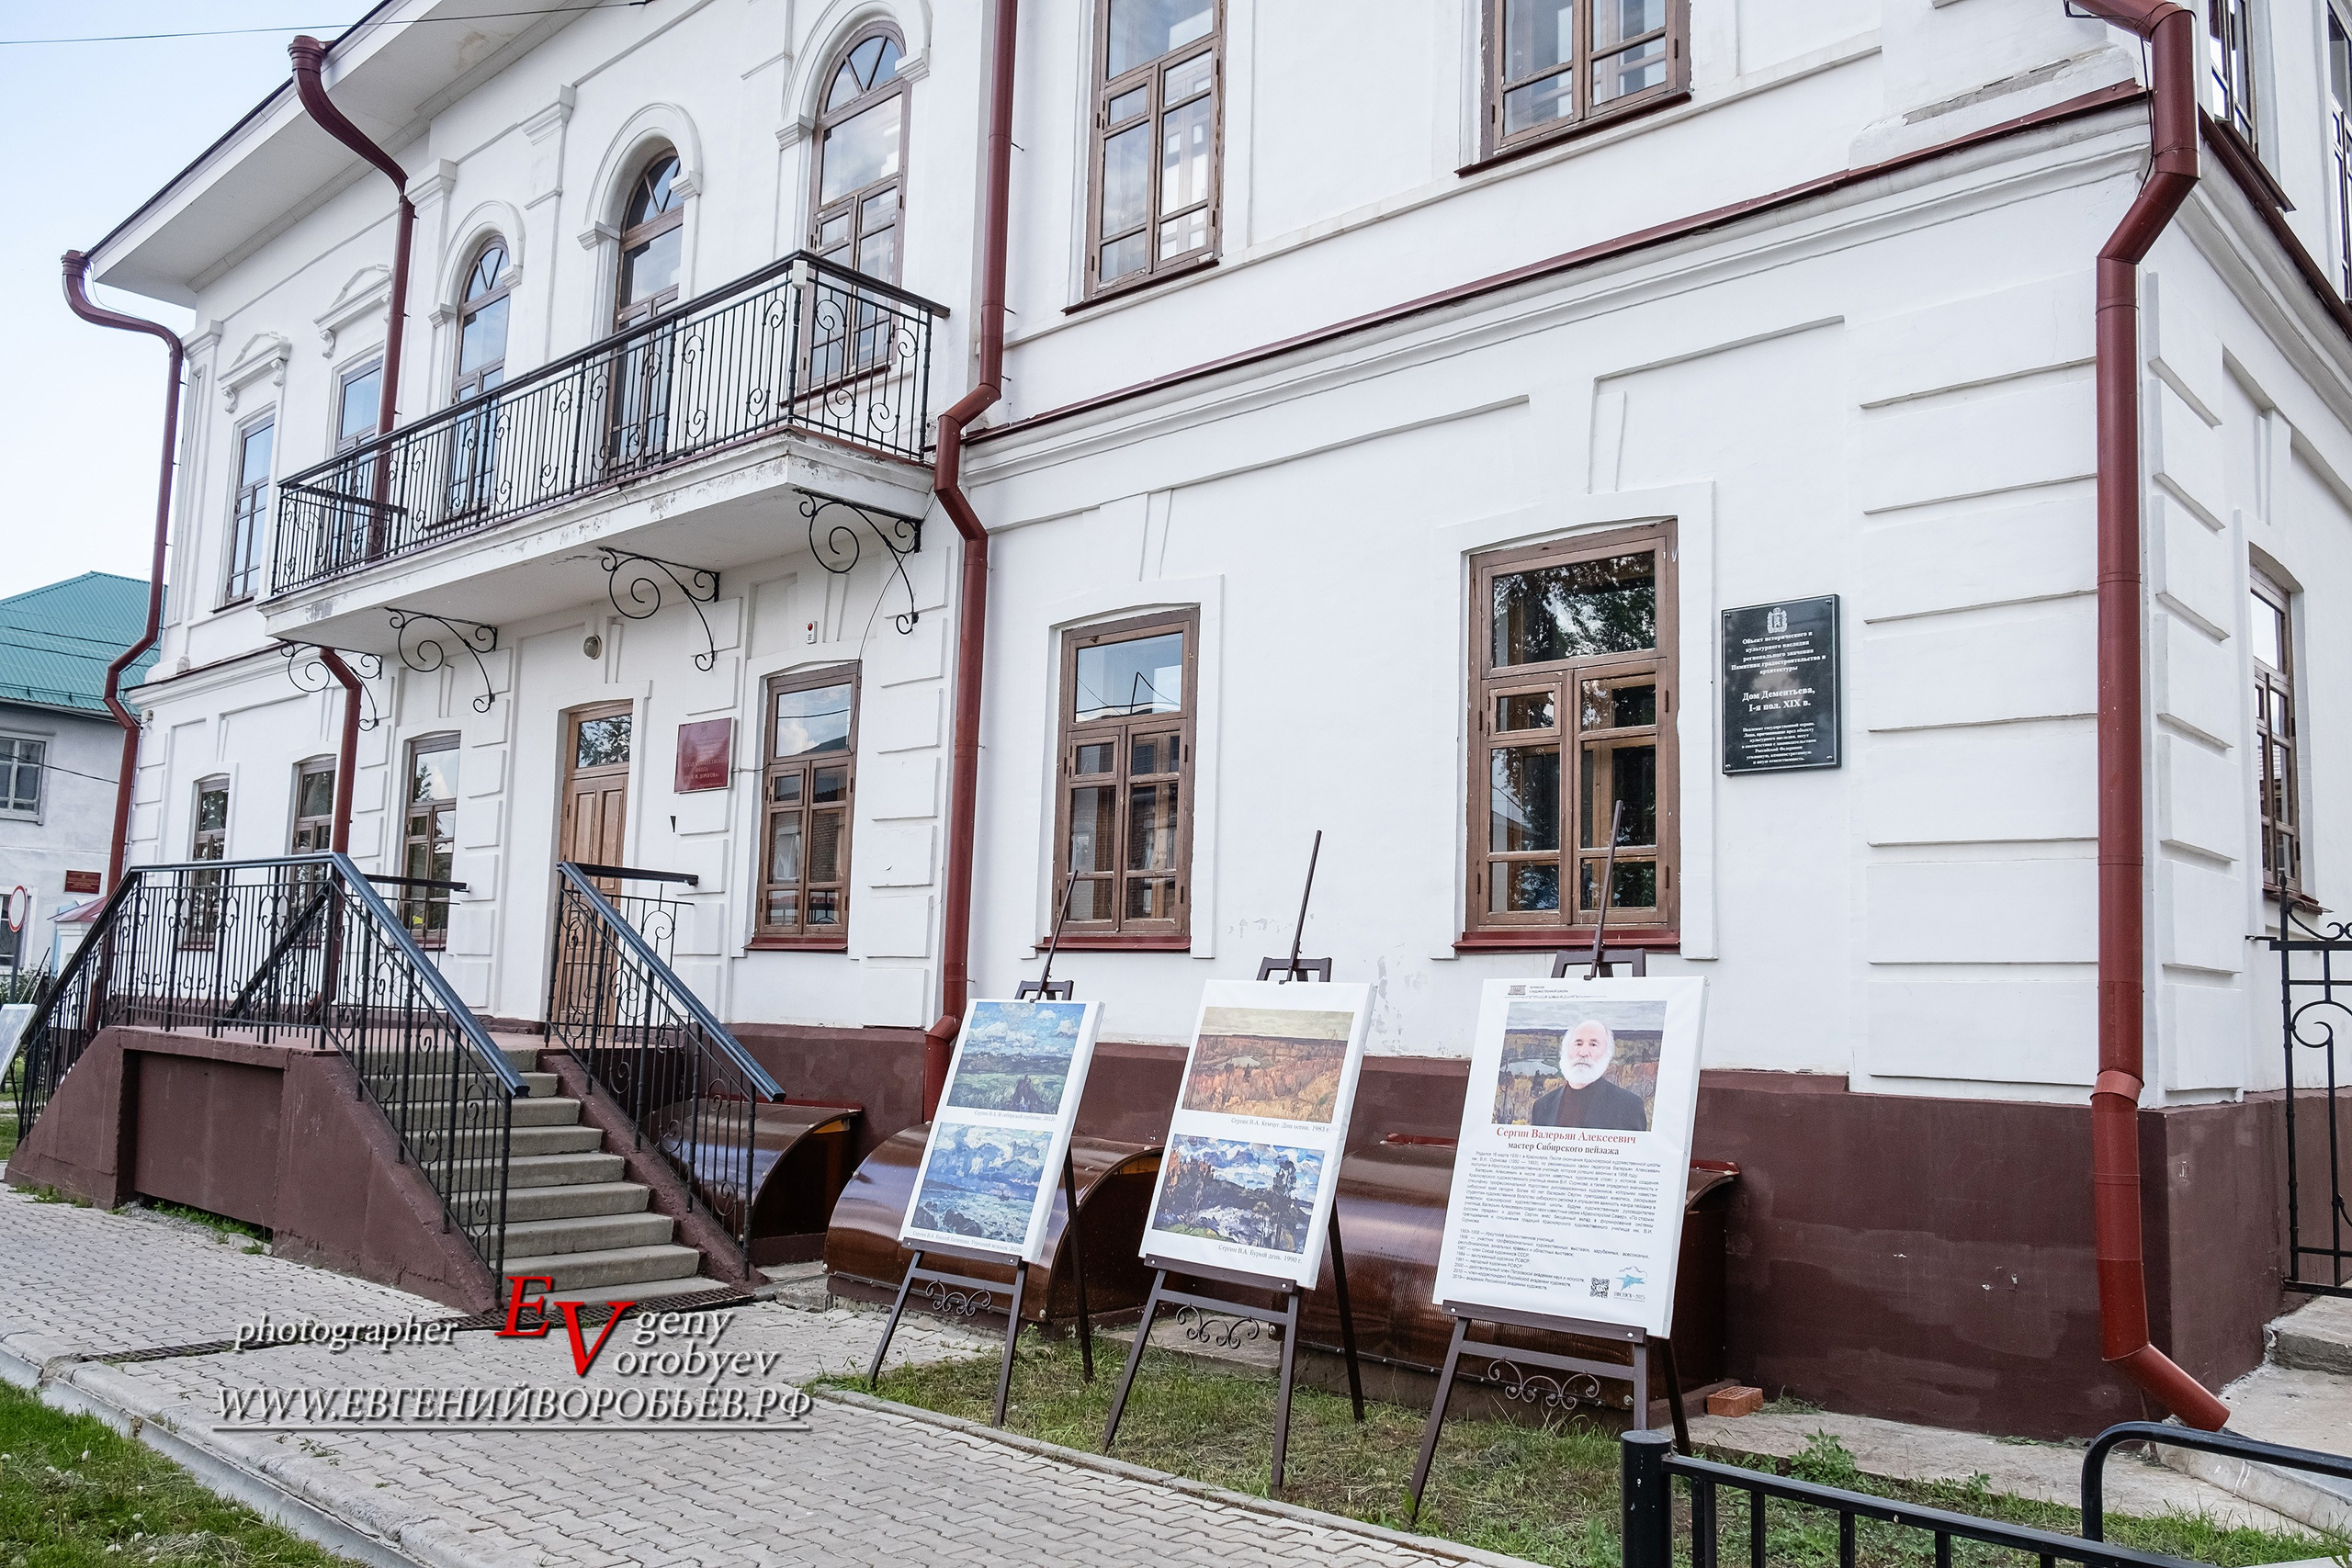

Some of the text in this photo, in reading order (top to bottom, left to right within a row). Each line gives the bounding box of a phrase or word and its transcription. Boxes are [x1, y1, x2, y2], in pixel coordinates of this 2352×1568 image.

[1765, 632, 1807, 641] исторического
[1745, 644, 1781, 653] культурного
[1743, 652, 1785, 662] регионального
[1759, 666, 1798, 675] архитектуры
[1742, 686, 1815, 702] Дом Дементьева,
[1495, 1126, 1636, 1144] Сергин Валерьян Алексеевич
[1507, 1141, 1619, 1155] мастер Сибирского пейзажа
[1219, 1244, 1237, 1253] Сергин
